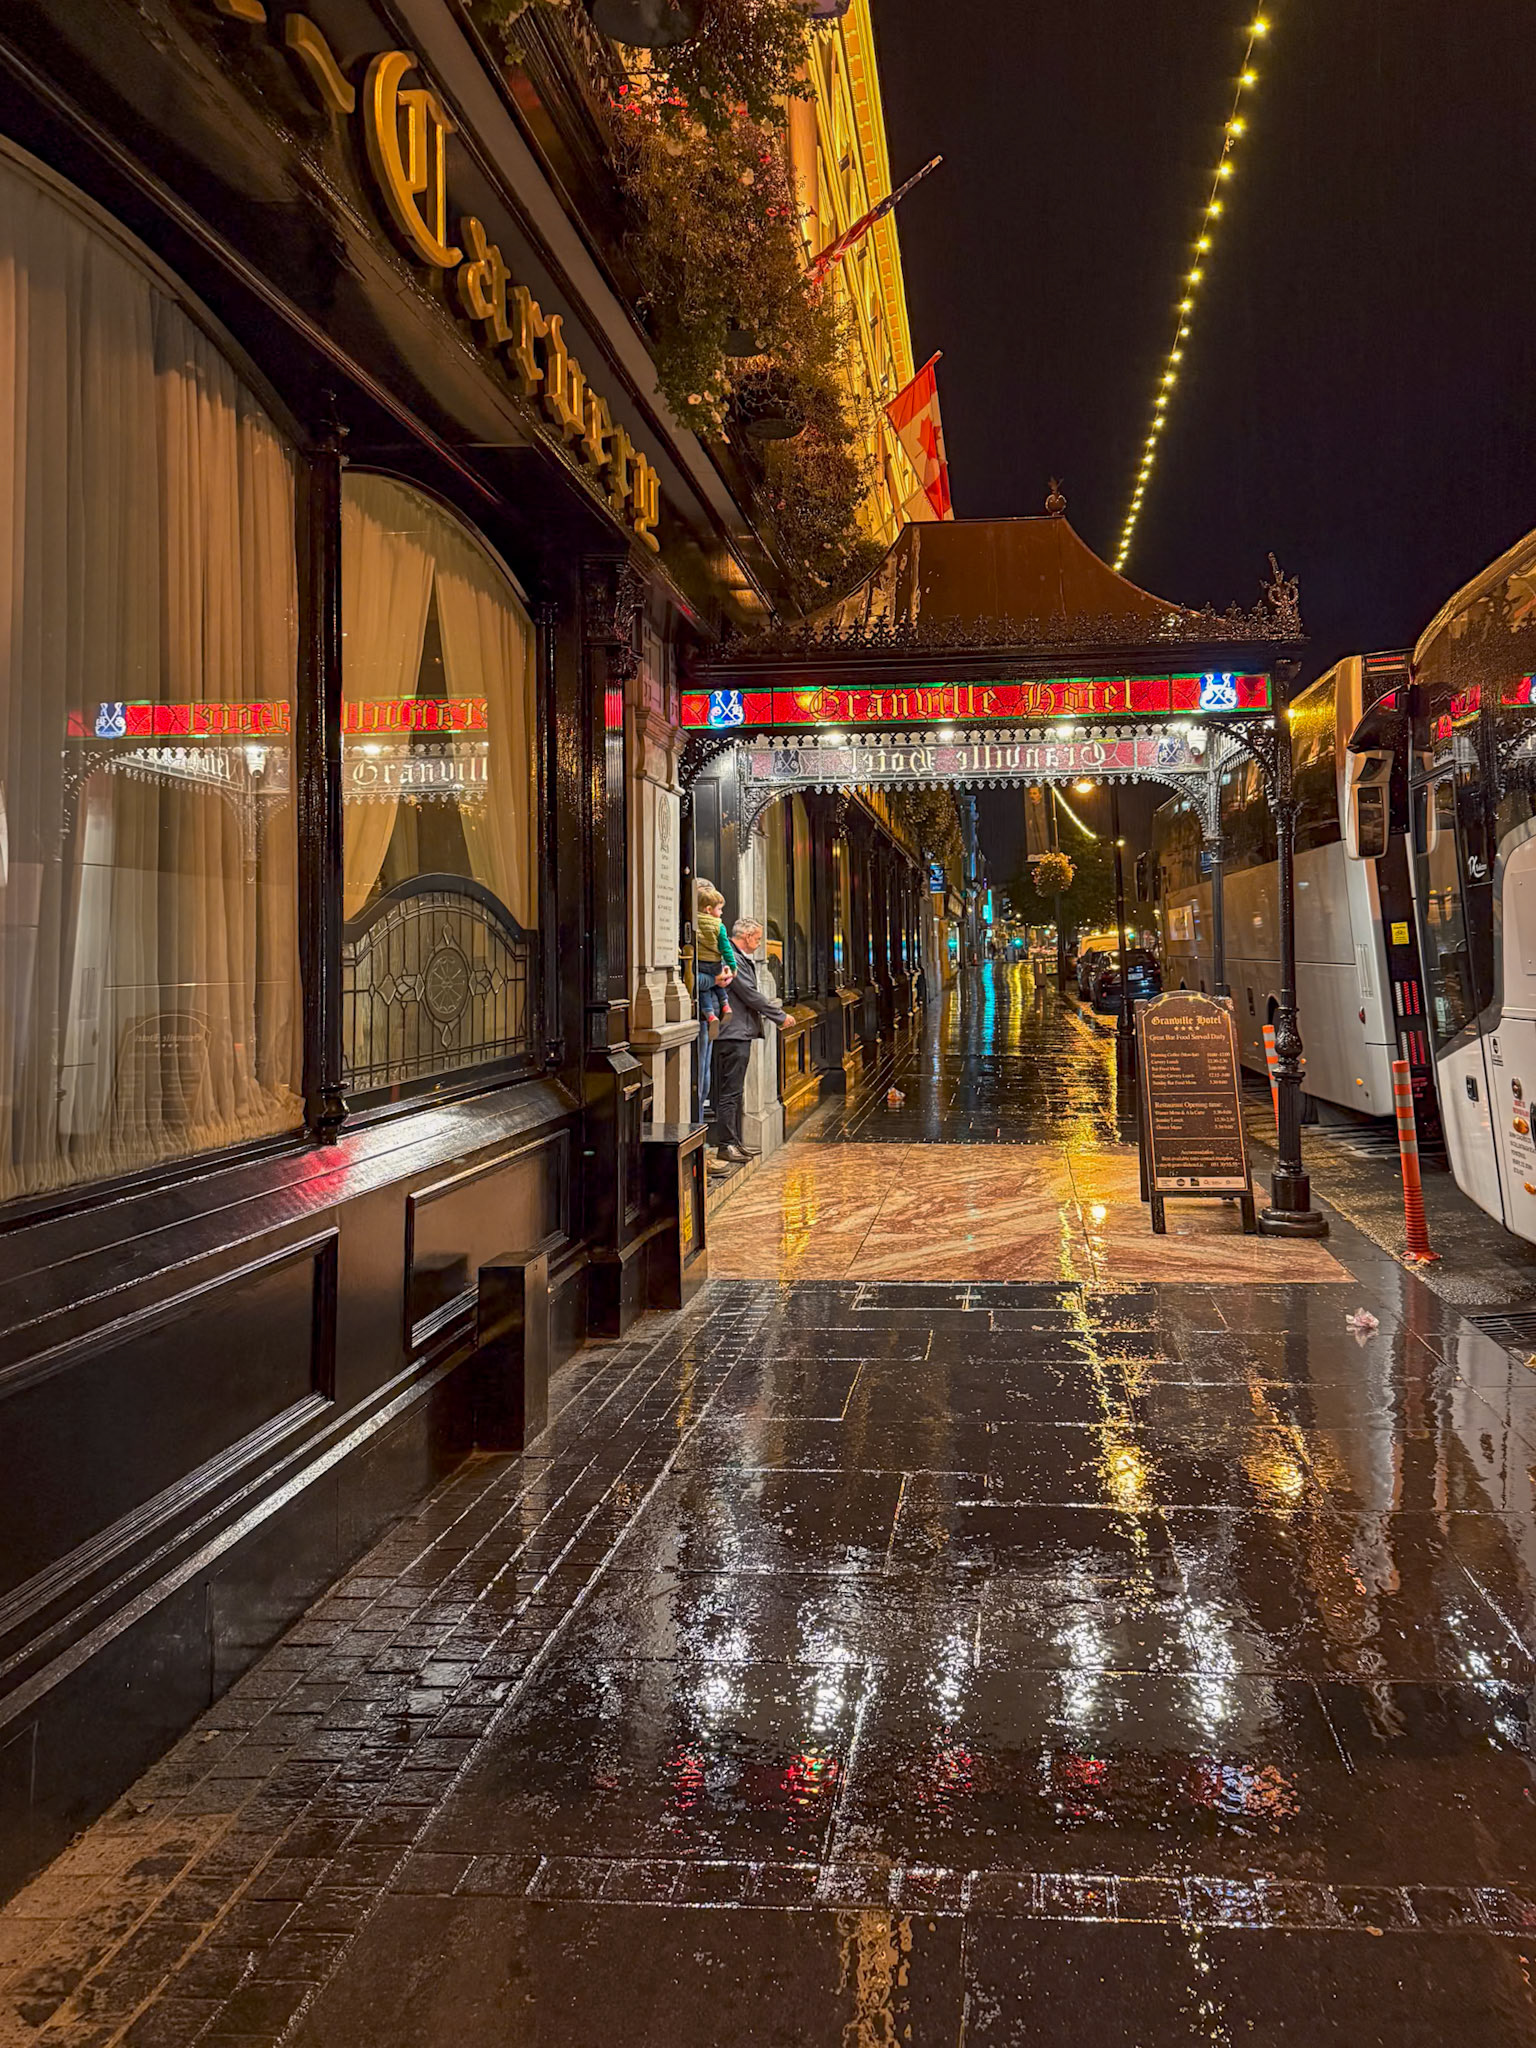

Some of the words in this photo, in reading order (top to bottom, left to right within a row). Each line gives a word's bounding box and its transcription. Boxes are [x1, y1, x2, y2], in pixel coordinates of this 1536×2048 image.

[359, 49, 662, 553] Carvery
[810, 684, 998, 720] Granville
[1020, 678, 1133, 719] Hotel
[353, 757, 488, 785] Granvill
[1151, 1015, 1194, 1026] Granville
[1195, 1015, 1222, 1026] Hotel
